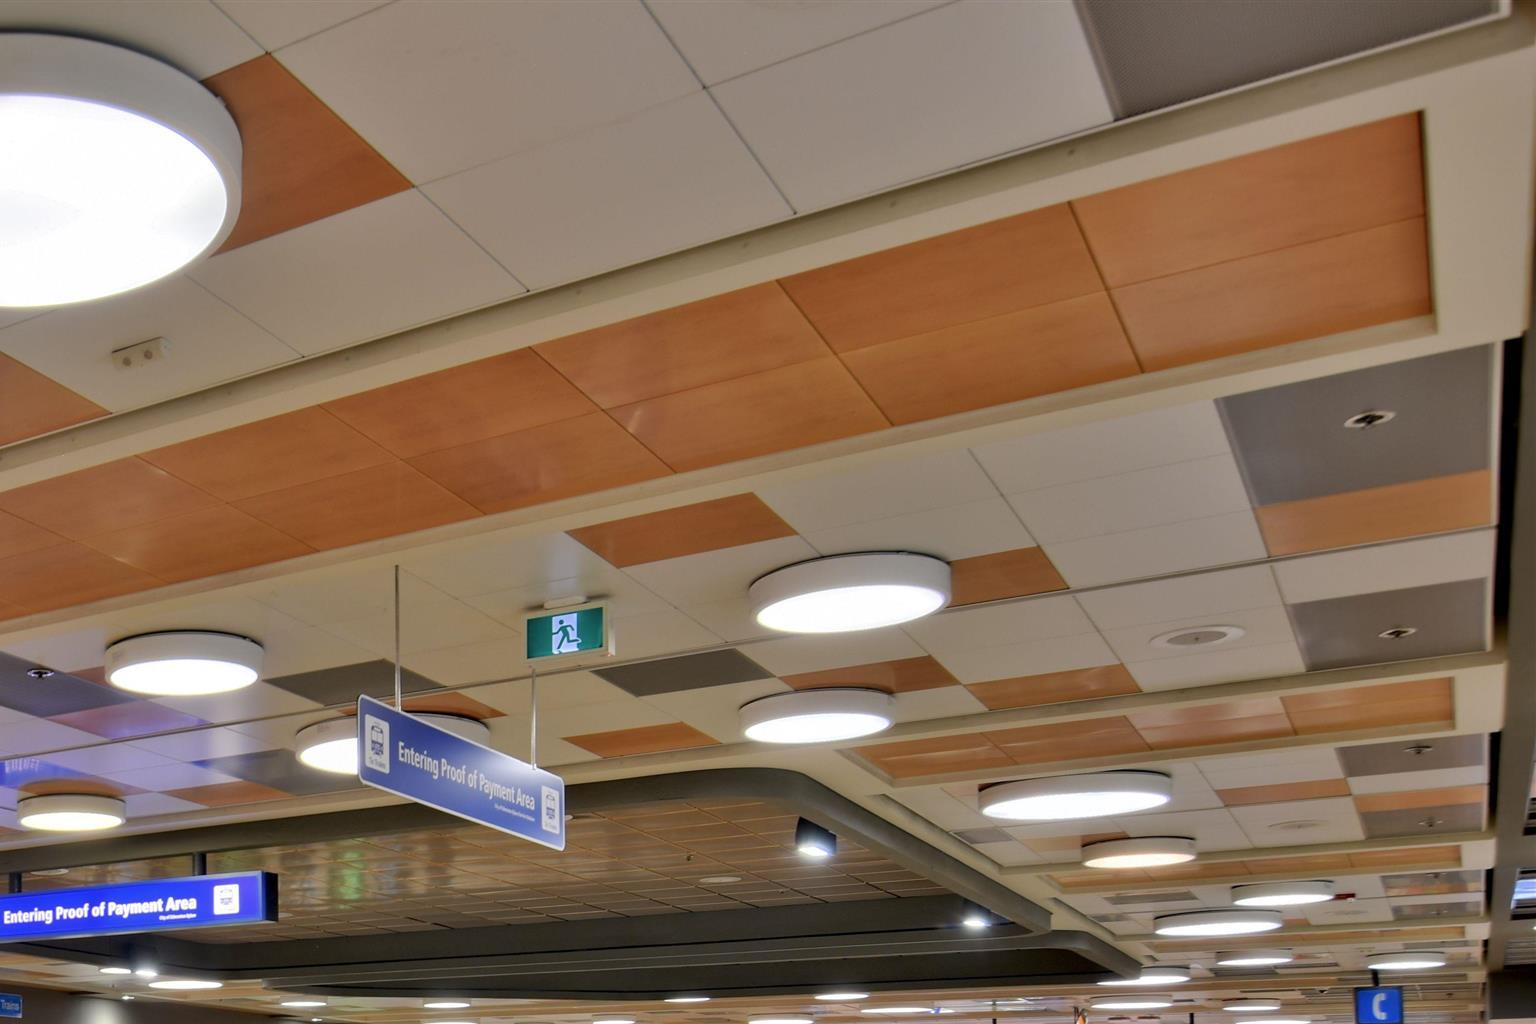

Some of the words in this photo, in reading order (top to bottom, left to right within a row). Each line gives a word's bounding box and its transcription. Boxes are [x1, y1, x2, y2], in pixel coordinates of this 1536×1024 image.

[398, 741, 439, 780] Entering
[441, 758, 466, 784] Proof
[467, 769, 478, 789] of
[479, 774, 515, 803] Payment
[516, 787, 535, 811] Area
[4, 907, 53, 924] Entering
[55, 903, 89, 920] Proof
[91, 901, 105, 917] of
[107, 898, 163, 919] Payment
[165, 896, 197, 912] Area
